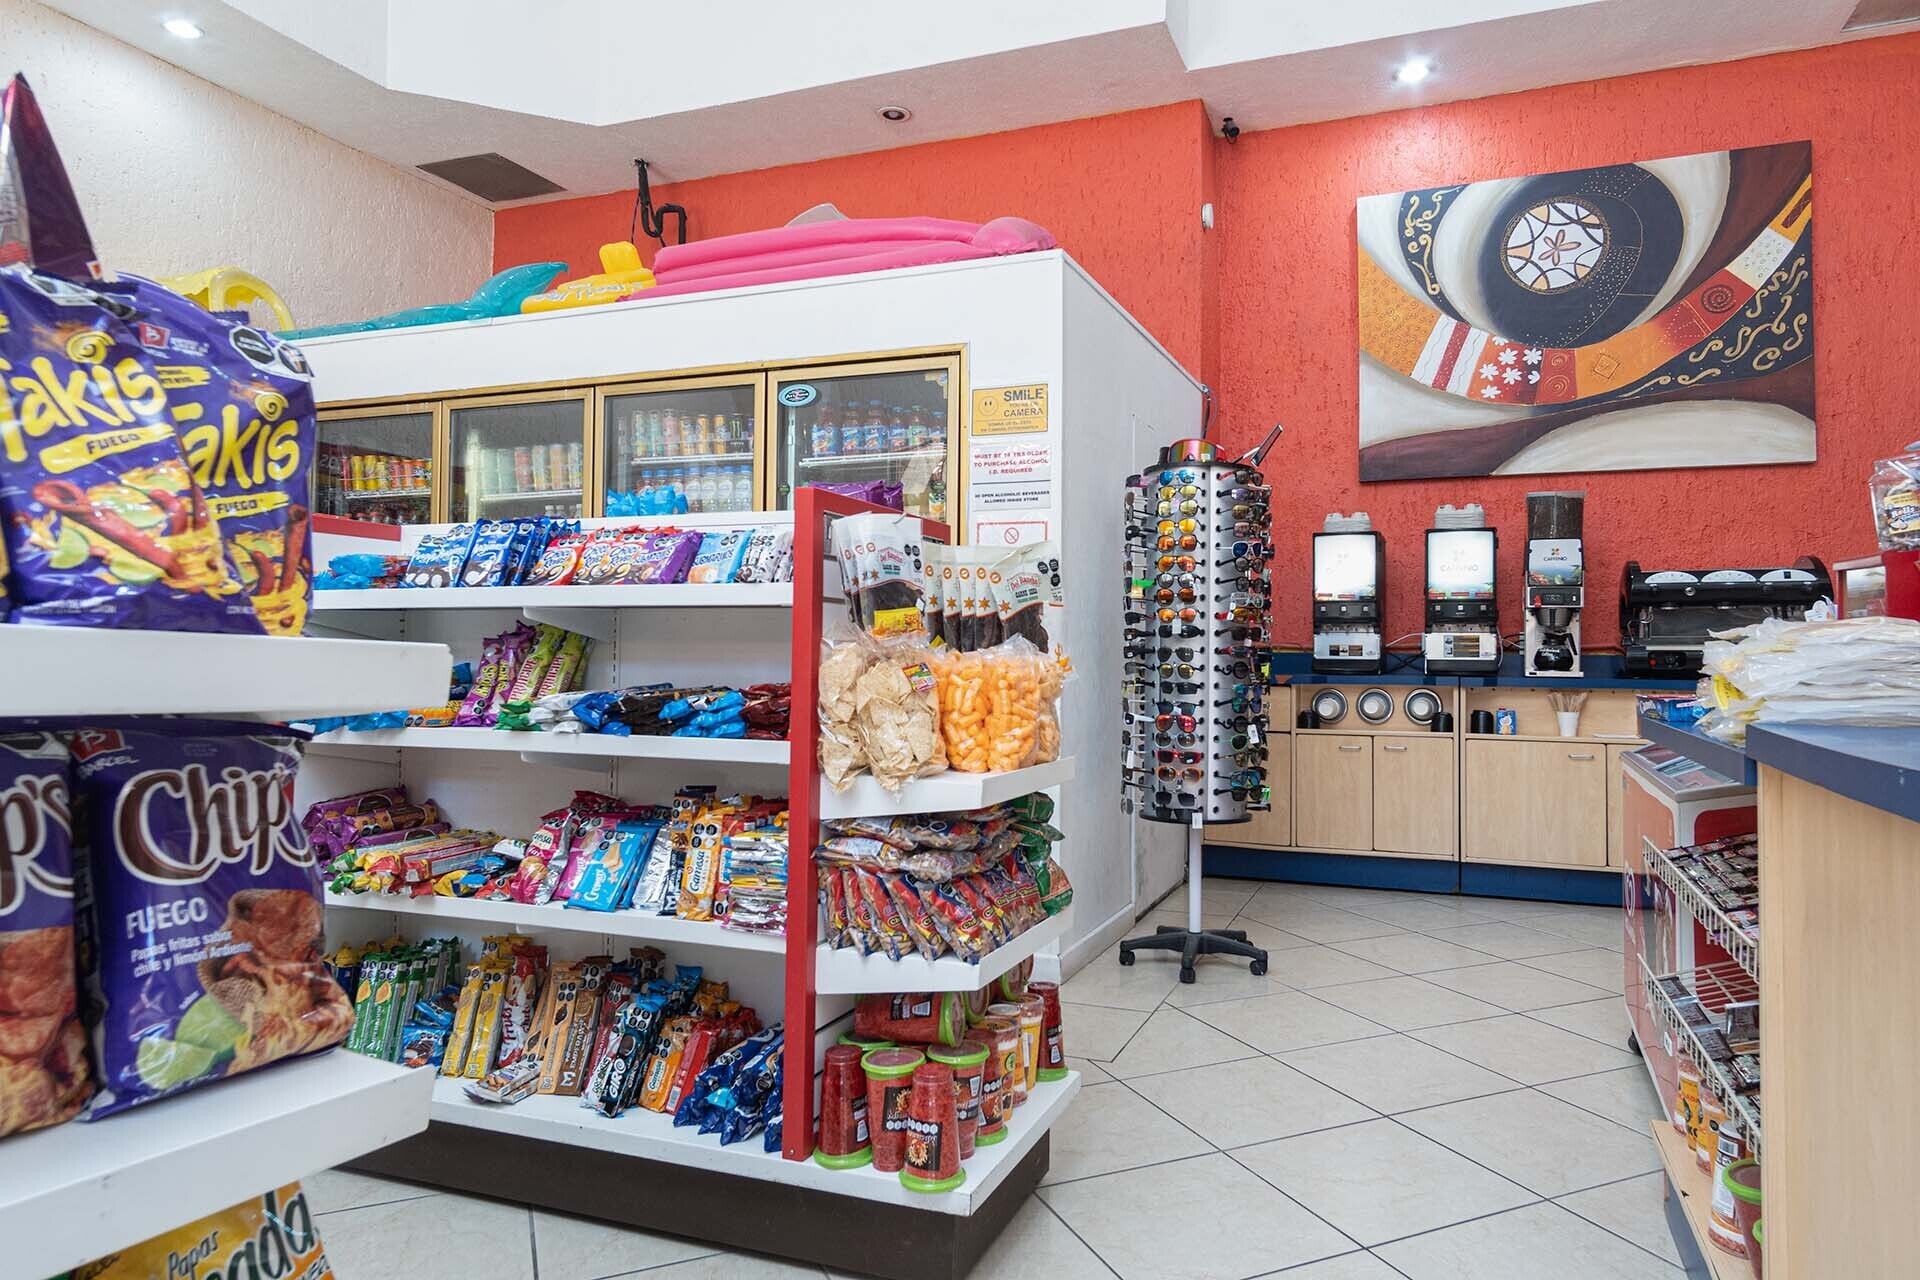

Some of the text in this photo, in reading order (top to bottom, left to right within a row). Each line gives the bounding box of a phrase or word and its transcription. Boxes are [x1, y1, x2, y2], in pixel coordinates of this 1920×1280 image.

[1003, 388, 1044, 402] SMILE
[1003, 407, 1044, 417] CAMERA
[86, 432, 141, 455] FUEGO
[216, 500, 257, 514] FUEGO
[689, 850, 705, 892] Gamesa
[126, 896, 209, 939] FUEGO
[130, 943, 168, 962] Papas
[168, 936, 202, 952] fritas
[162, 957, 173, 971] y
[609, 1058, 627, 1099] GIRO
[168, 1231, 219, 1280] Papas
